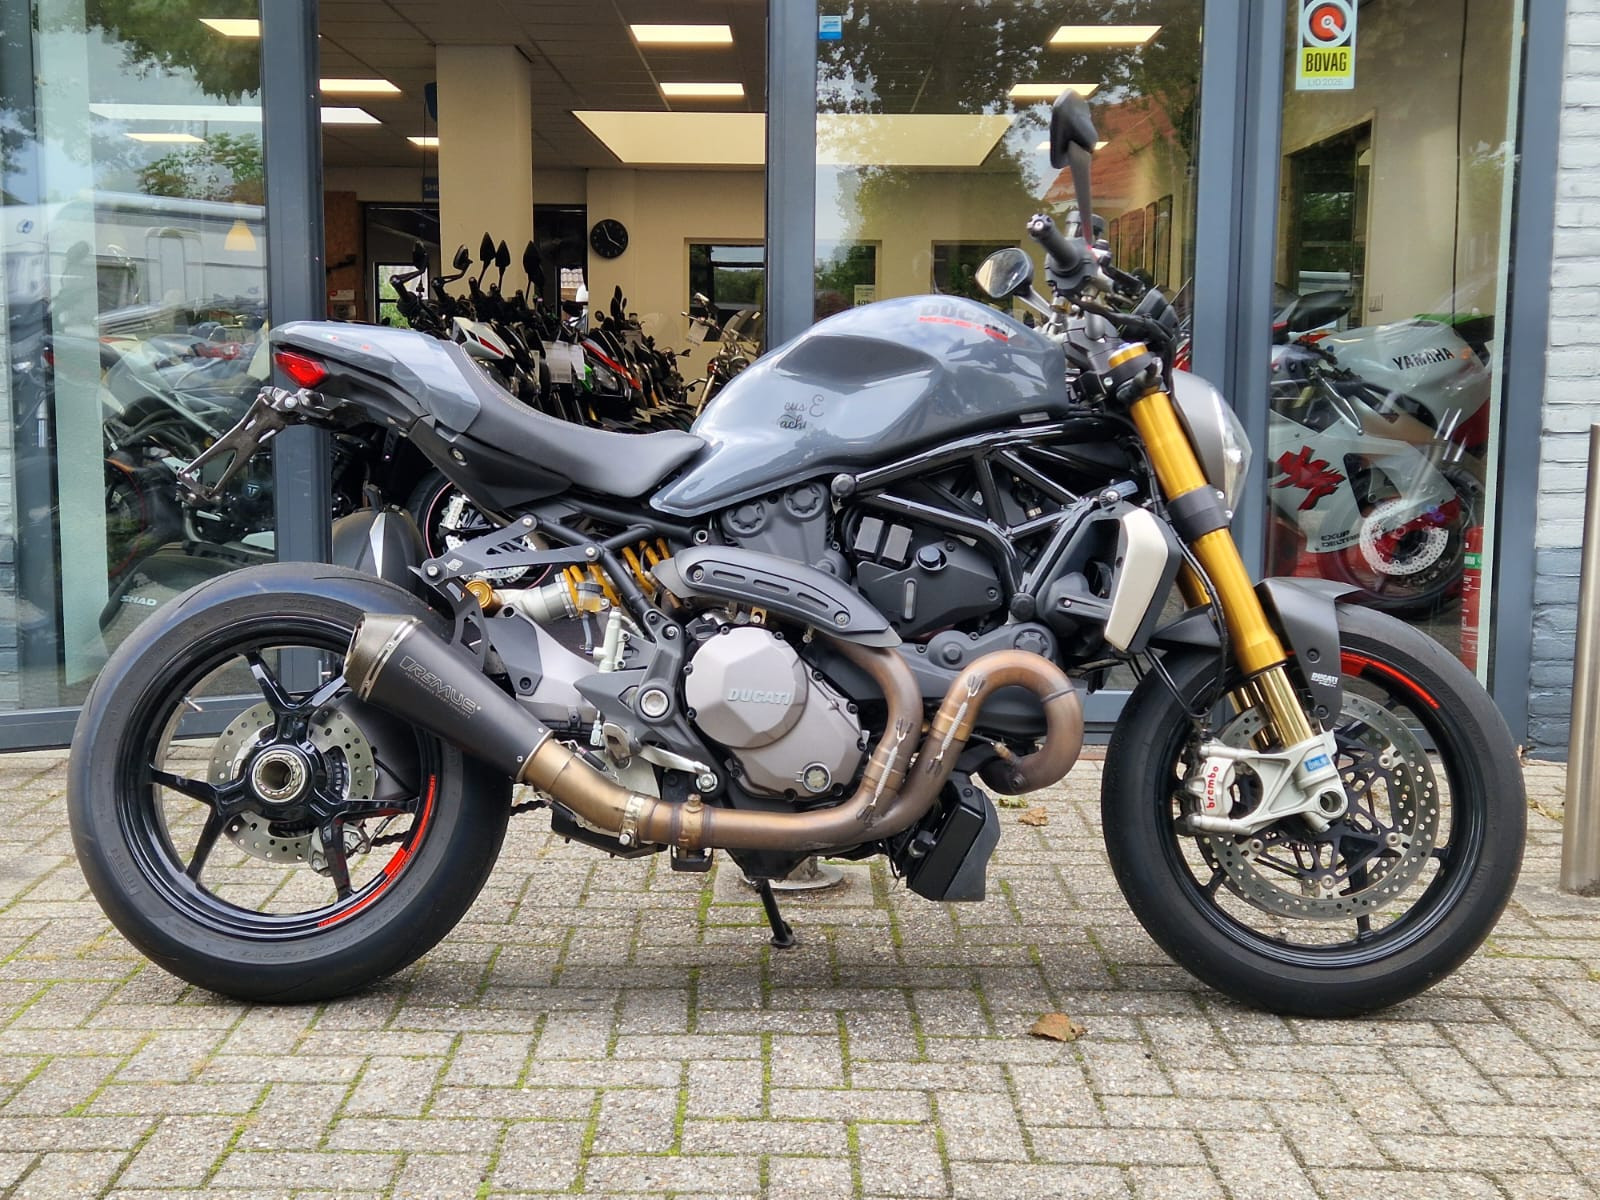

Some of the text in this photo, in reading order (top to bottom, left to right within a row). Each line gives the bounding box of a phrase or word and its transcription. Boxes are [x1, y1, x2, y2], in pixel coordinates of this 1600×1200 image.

[1305, 52, 1347, 72] BOVAG
[1392, 347, 1456, 370] YAMAHA
[120, 595, 157, 606] SHAD
[406, 662, 477, 715] REMUS
[727, 688, 791, 705] DUCATI
[1206, 766, 1219, 809] brembo
